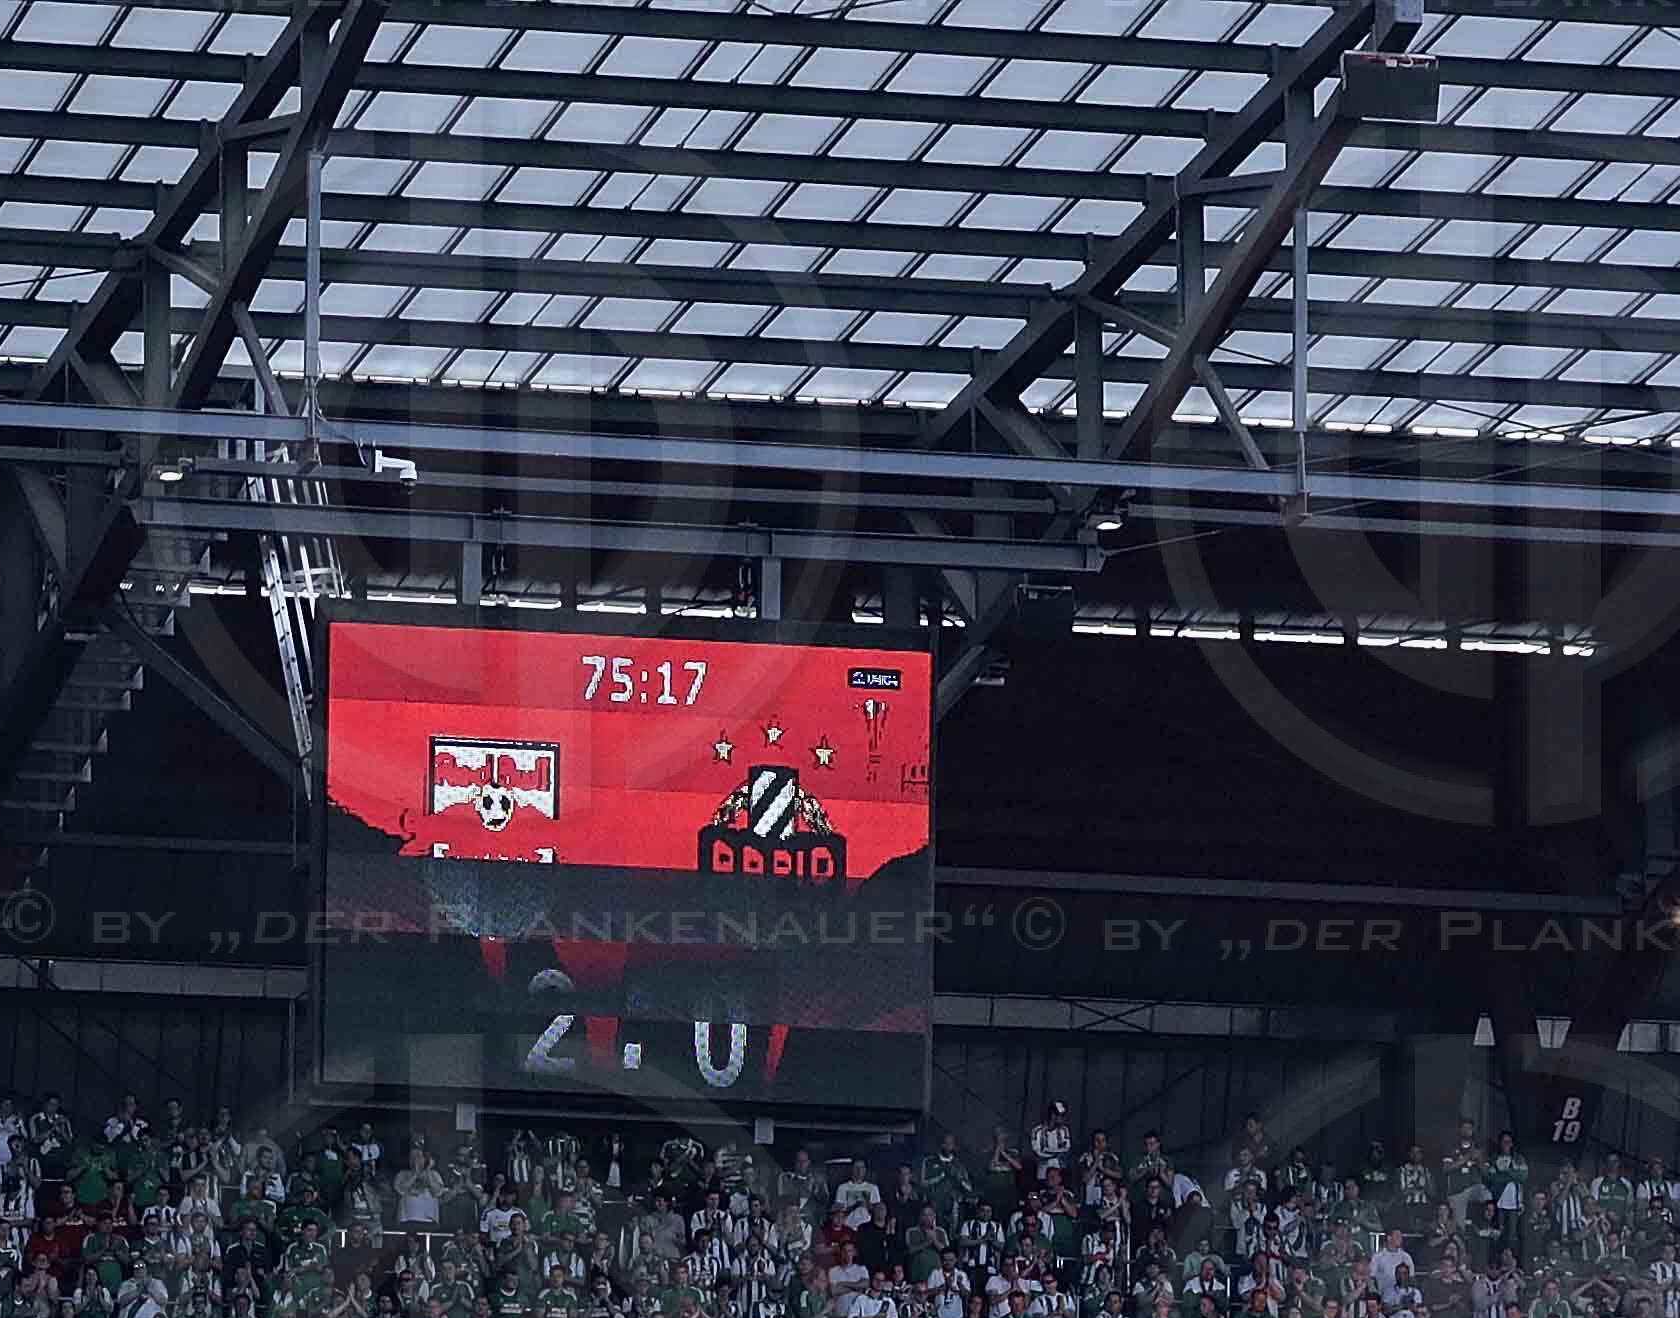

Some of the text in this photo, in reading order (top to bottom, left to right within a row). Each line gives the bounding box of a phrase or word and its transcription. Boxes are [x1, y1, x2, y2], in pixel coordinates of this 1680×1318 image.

[581, 655, 707, 705] 75:17
[1562, 1098, 1580, 1119] B
[1553, 1120, 1581, 1141] 19
